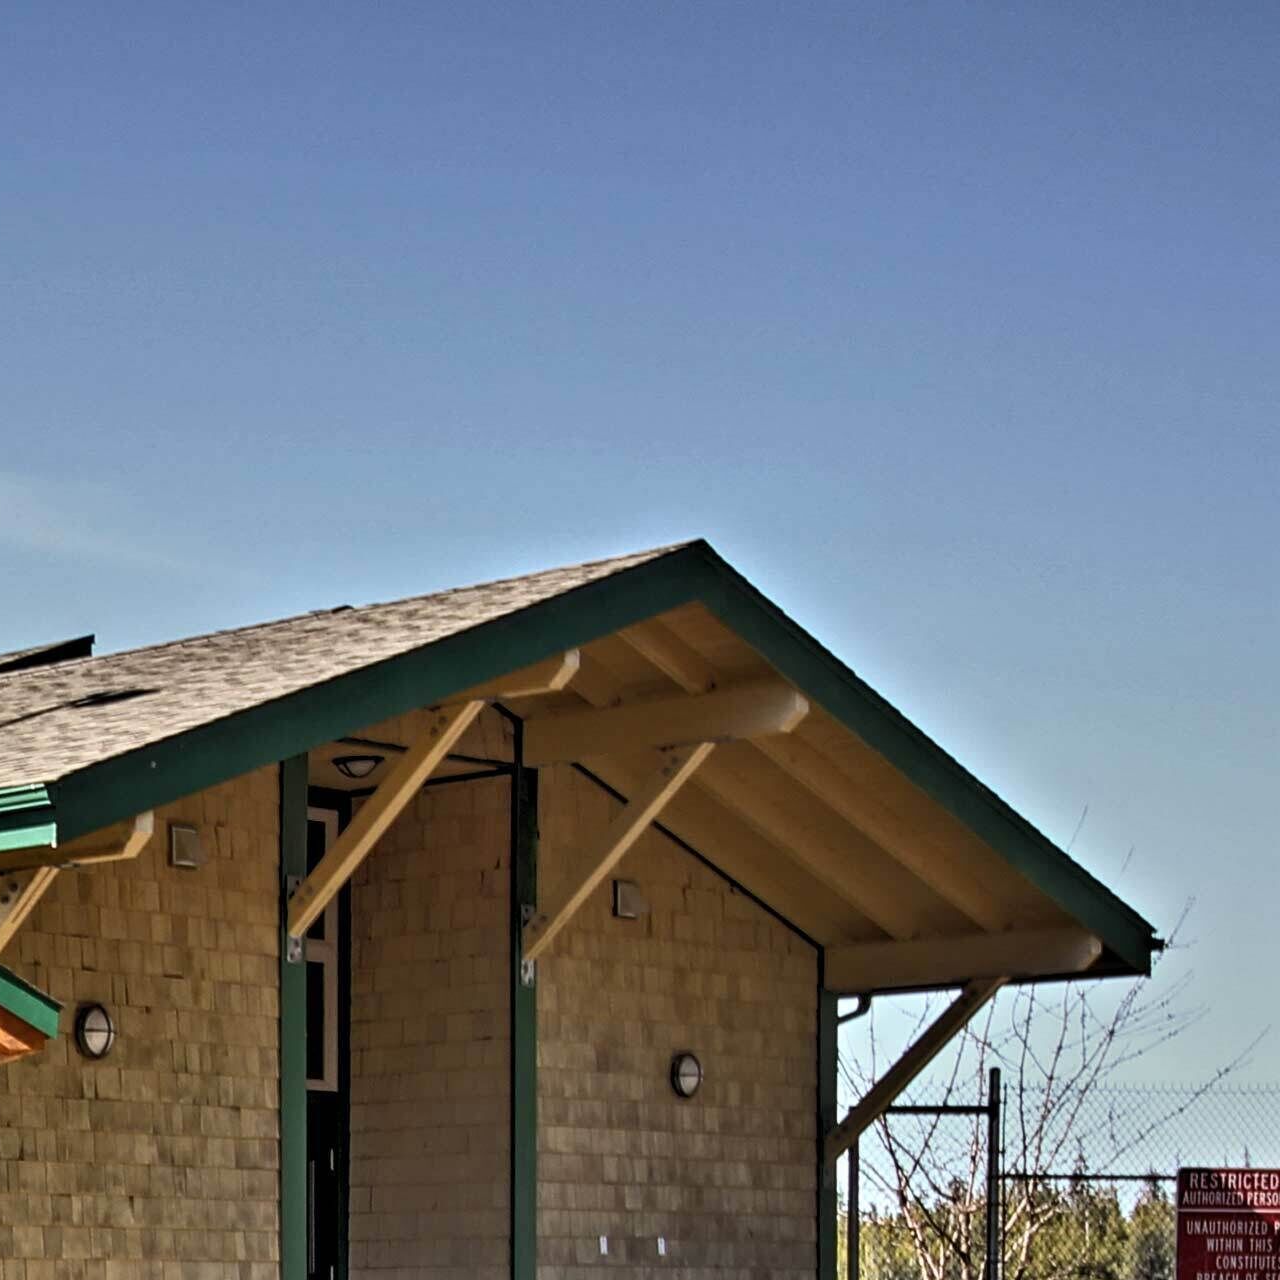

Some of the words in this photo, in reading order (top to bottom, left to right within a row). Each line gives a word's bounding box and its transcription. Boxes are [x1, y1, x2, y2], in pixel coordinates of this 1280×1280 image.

[1190, 1172, 1279, 1190] RESTRICTED
[1182, 1191, 1243, 1206] AUTHORIZED
[1246, 1192, 1280, 1206] PERSO
[1186, 1220, 1268, 1235] UNAUTHORIZED
[1206, 1238, 1243, 1252] WITHIN
[1250, 1238, 1273, 1252] THIS
